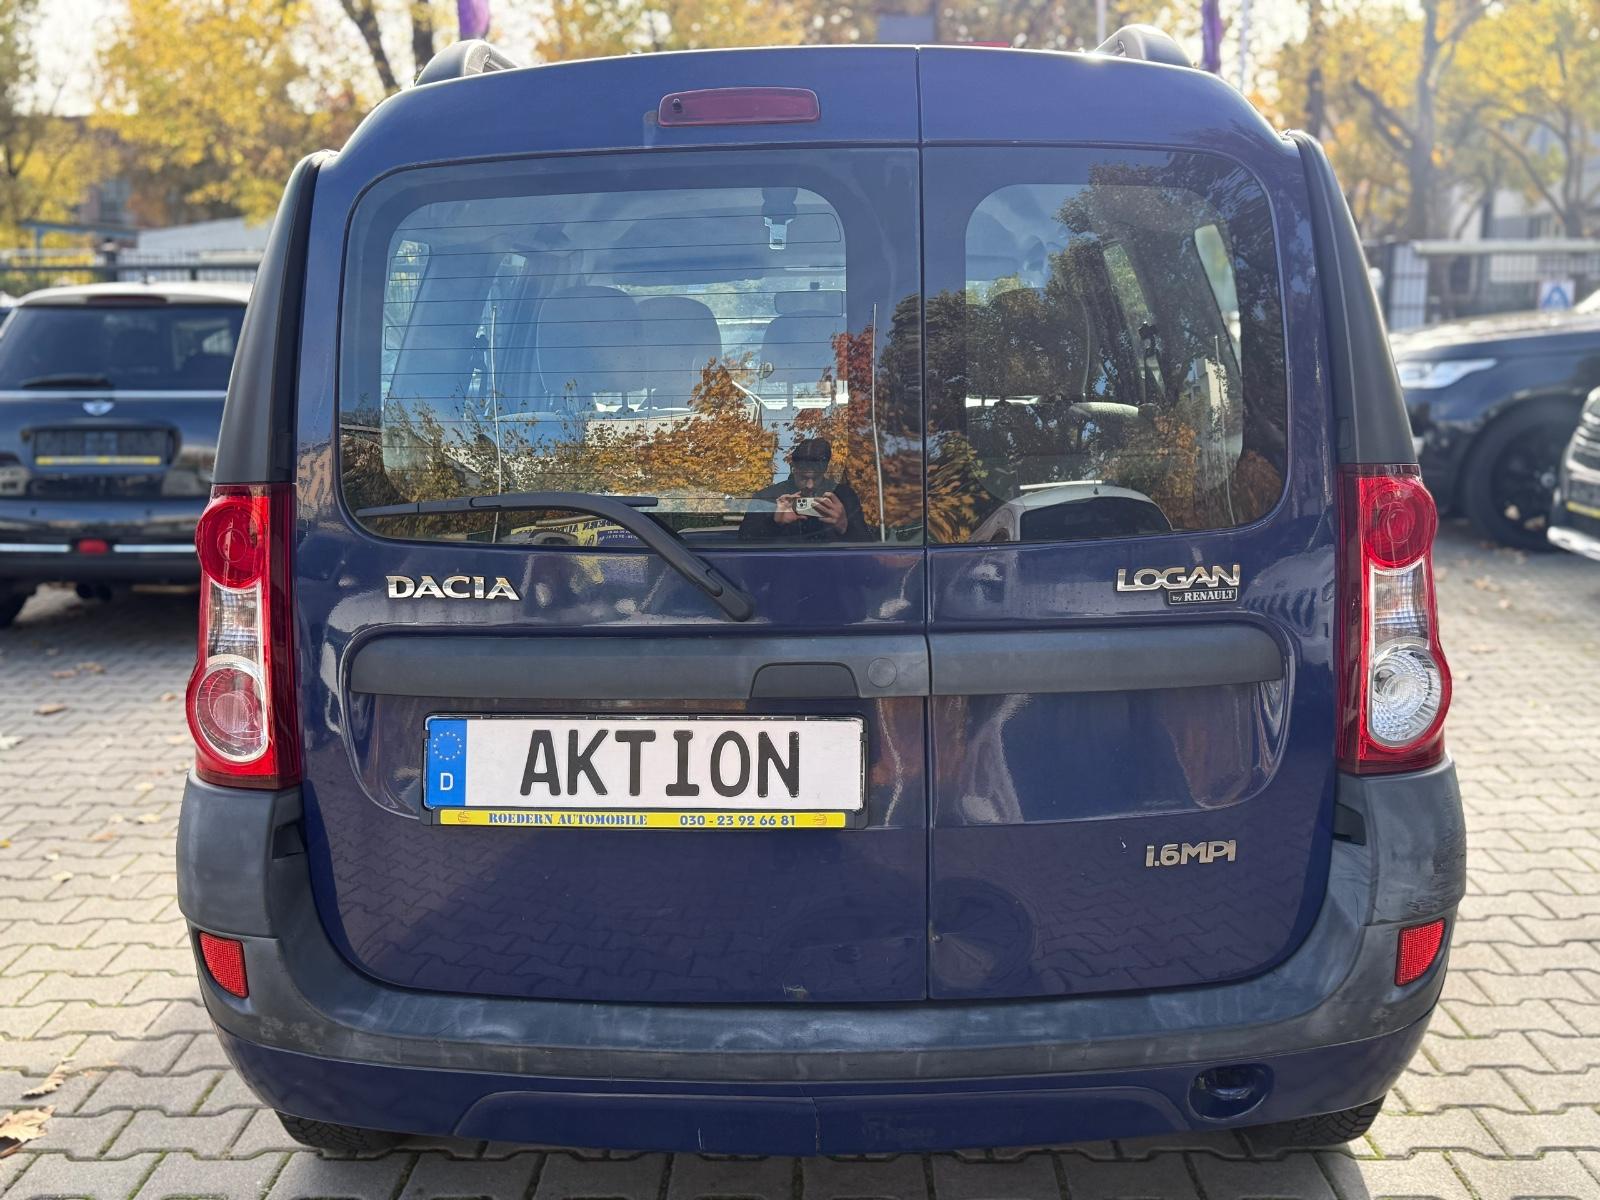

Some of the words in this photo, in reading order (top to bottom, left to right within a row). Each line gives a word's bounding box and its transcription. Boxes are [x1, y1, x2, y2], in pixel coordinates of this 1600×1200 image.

[385, 575, 520, 600] DACIA
[1117, 564, 1240, 592] LOGAN
[1172, 594, 1182, 602] by
[1184, 589, 1235, 602] RENAULT
[520, 729, 800, 798] AKTION
[440, 772, 454, 791] D
[488, 812, 554, 825] ROEDERN
[557, 813, 648, 826] AUTOMOBILE
[680, 815, 705, 826] 030
[717, 815, 734, 826] 23
[738, 815, 755, 827] 92
[759, 815, 777, 827] 66
[781, 815, 796, 827] 81
[1145, 840, 1237, 867] 1.6MPI
